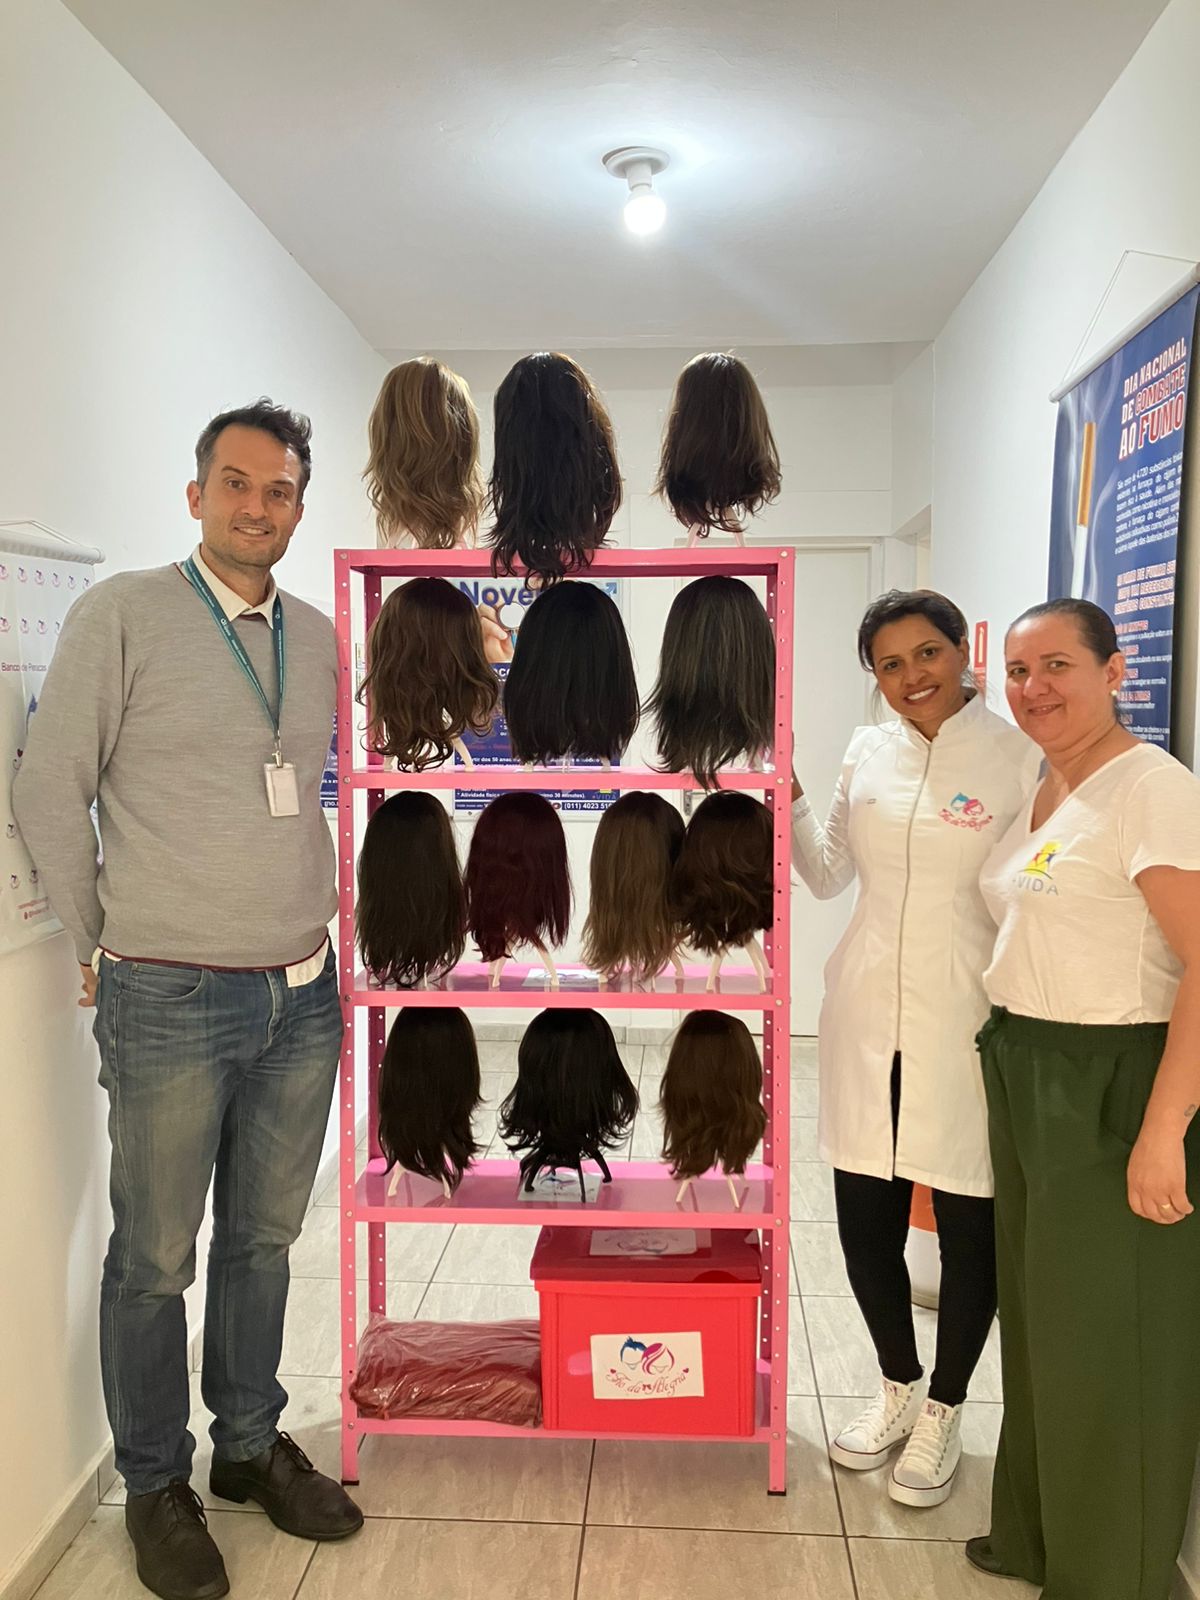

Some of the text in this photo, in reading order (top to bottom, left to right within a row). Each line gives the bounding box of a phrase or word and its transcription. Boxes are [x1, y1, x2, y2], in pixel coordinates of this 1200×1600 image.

[1123, 337, 1187, 398] DIA NACIONAL
[1121, 362, 1186, 425] DE COMBATE
[1118, 391, 1185, 460] AO FUMO
[459, 581, 541, 607] Nove
[1, 662, 20, 672] Banco
[564, 803, 582, 811] (011)
[1017, 876, 1059, 896] VIDA
[627, 1381, 643, 1393] da
